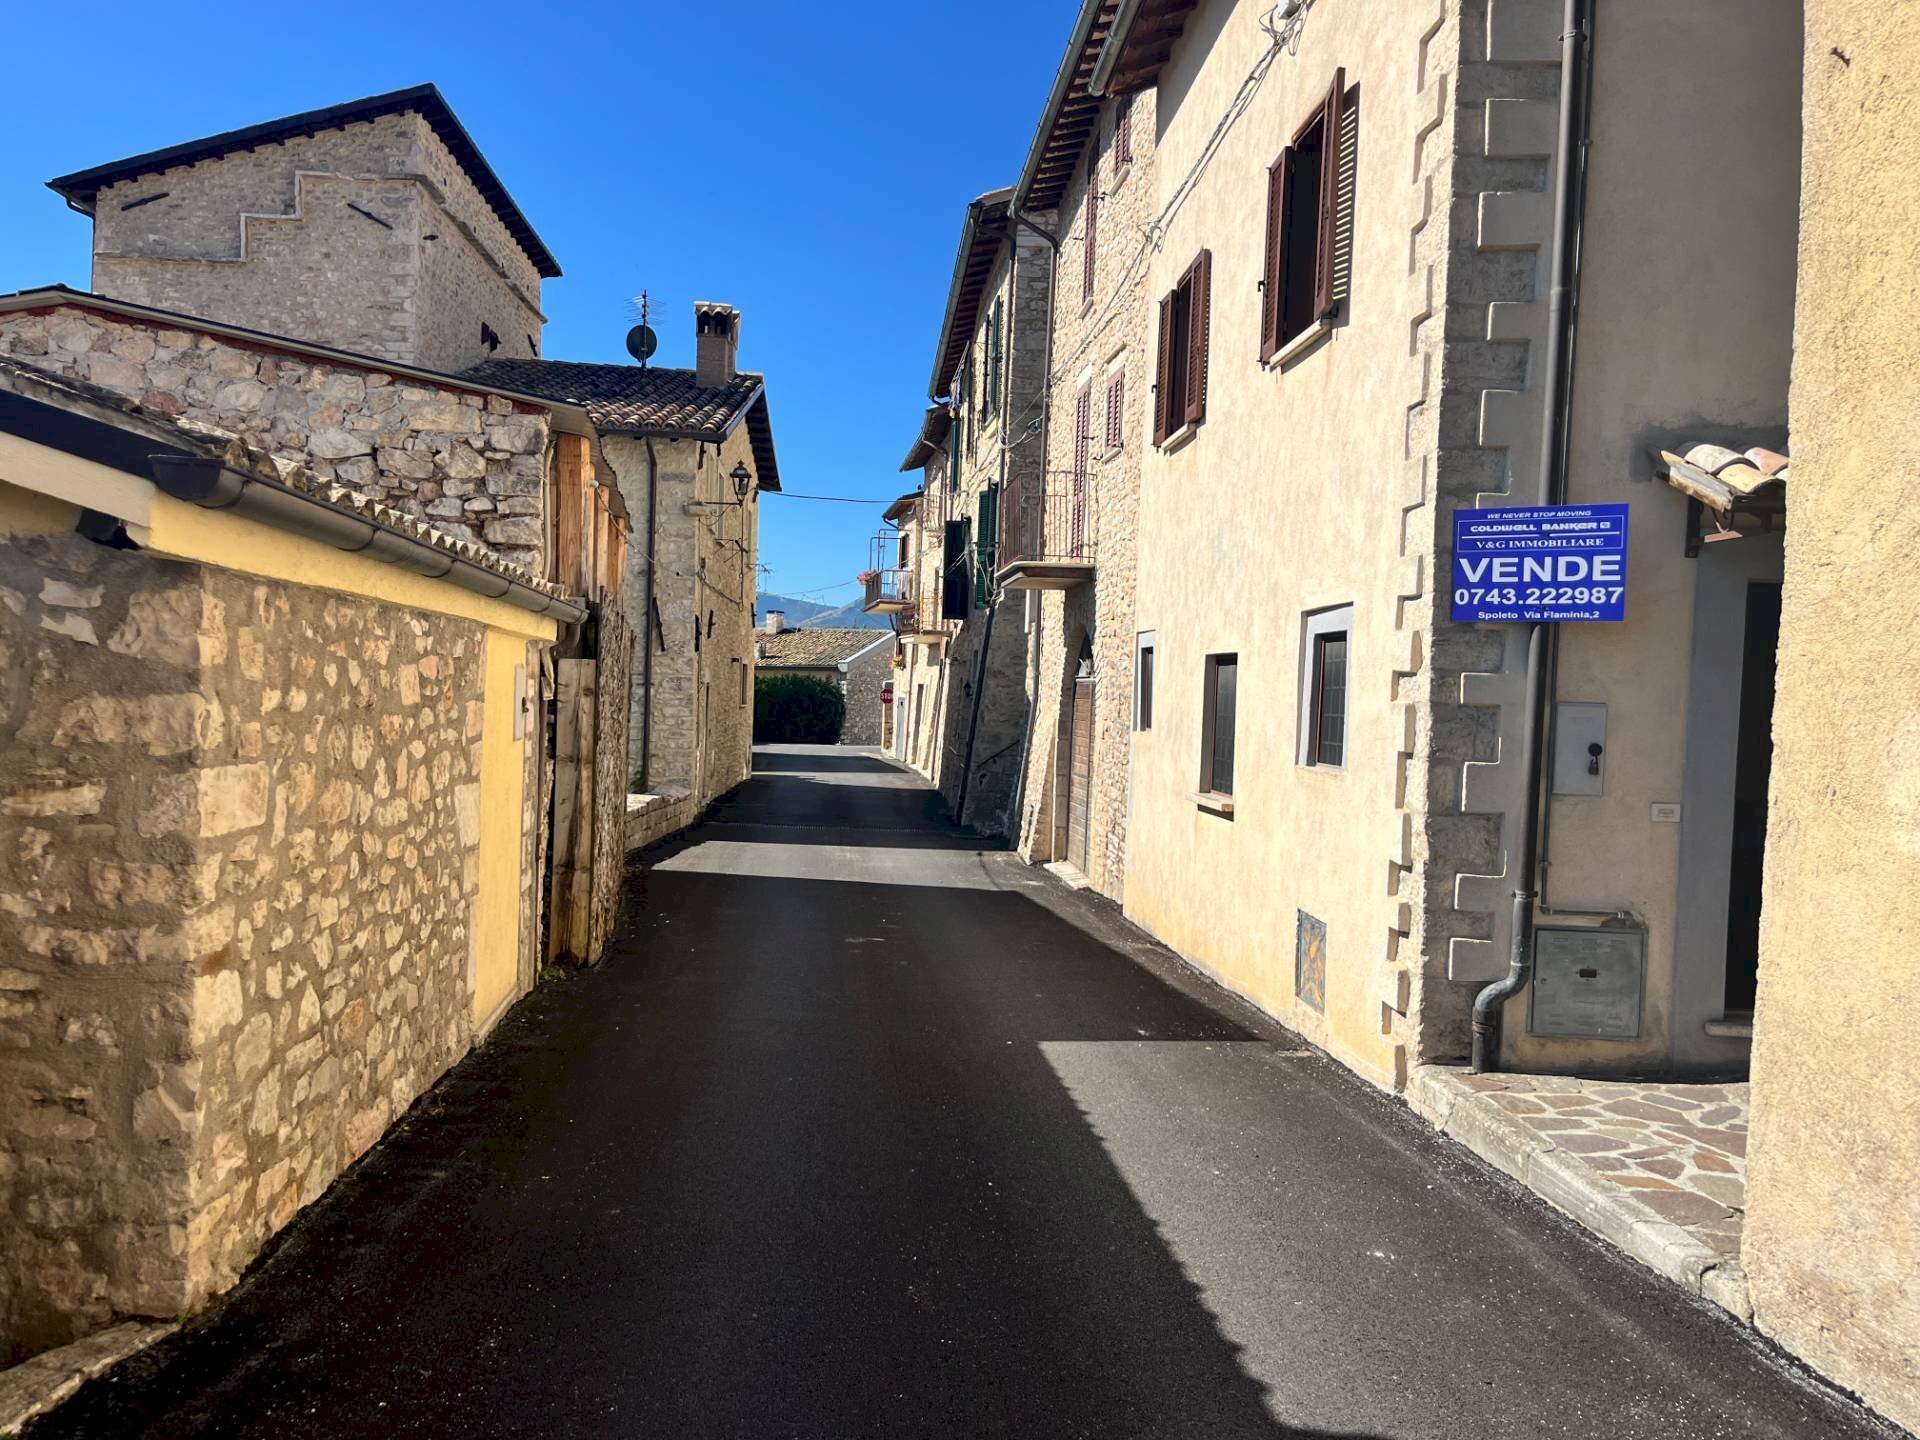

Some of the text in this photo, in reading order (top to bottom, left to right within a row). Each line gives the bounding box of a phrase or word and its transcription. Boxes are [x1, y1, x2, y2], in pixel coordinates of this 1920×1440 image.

[1470, 524, 1537, 532] COLDWELL
[1541, 522, 1597, 530] BANKER
[1476, 538, 1604, 549] V&G IMMOBILIARE
[1459, 555, 1621, 583] VENDE
[1454, 587, 1624, 605] 0743.222987
[1478, 611, 1518, 620] Spoleto
